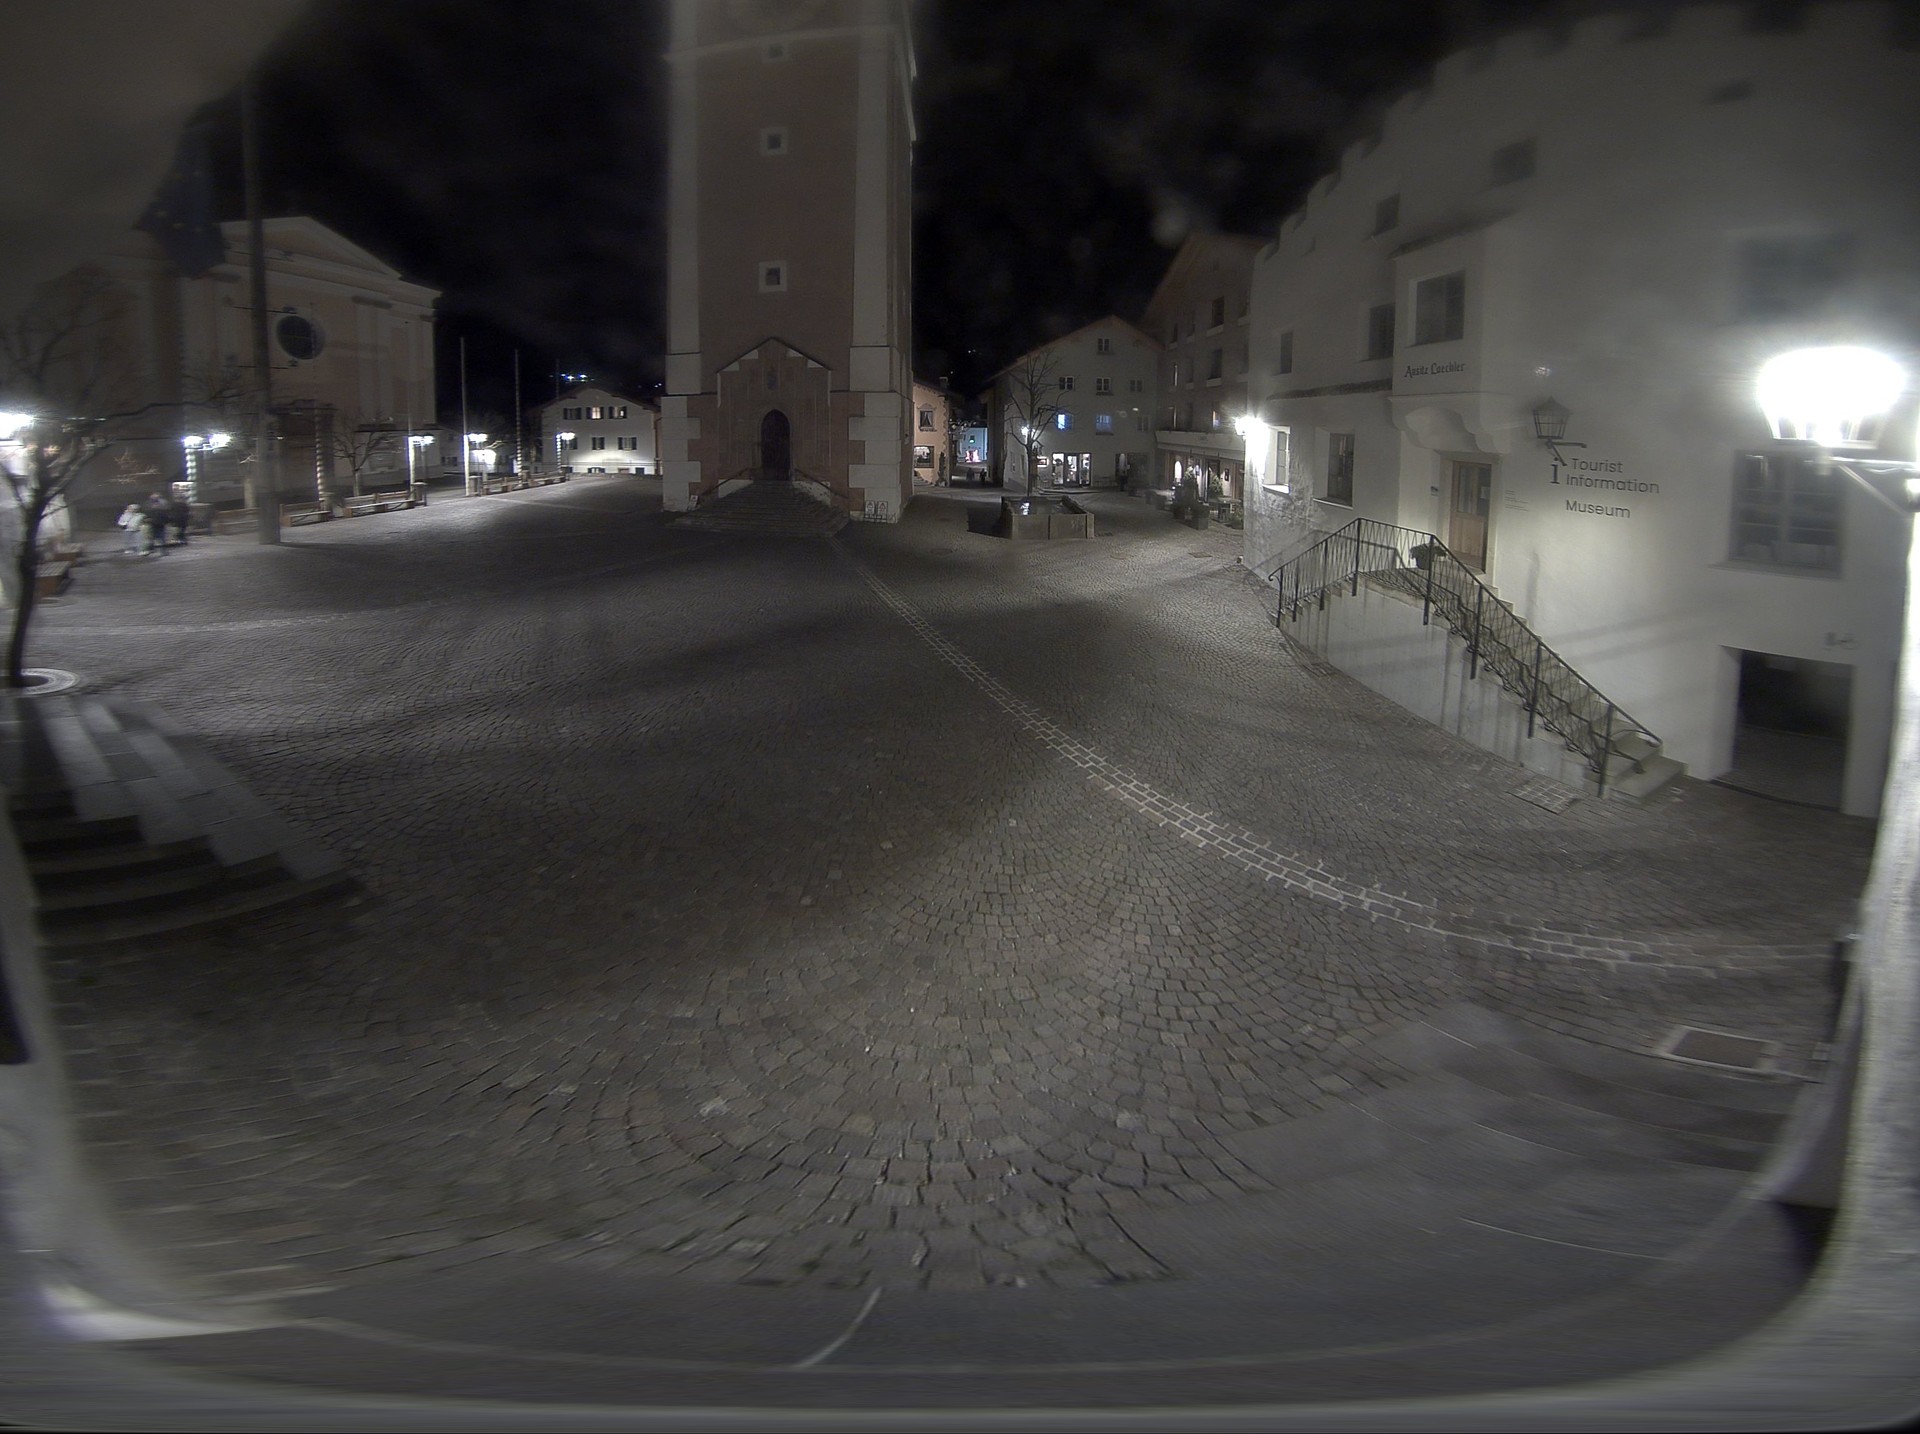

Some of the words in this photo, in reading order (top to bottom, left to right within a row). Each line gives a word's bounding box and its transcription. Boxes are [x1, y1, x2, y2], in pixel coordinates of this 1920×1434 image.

[1571, 458, 1623, 473] Tourist
[1566, 474, 1659, 493] Information
[1566, 500, 1630, 518] Museum
